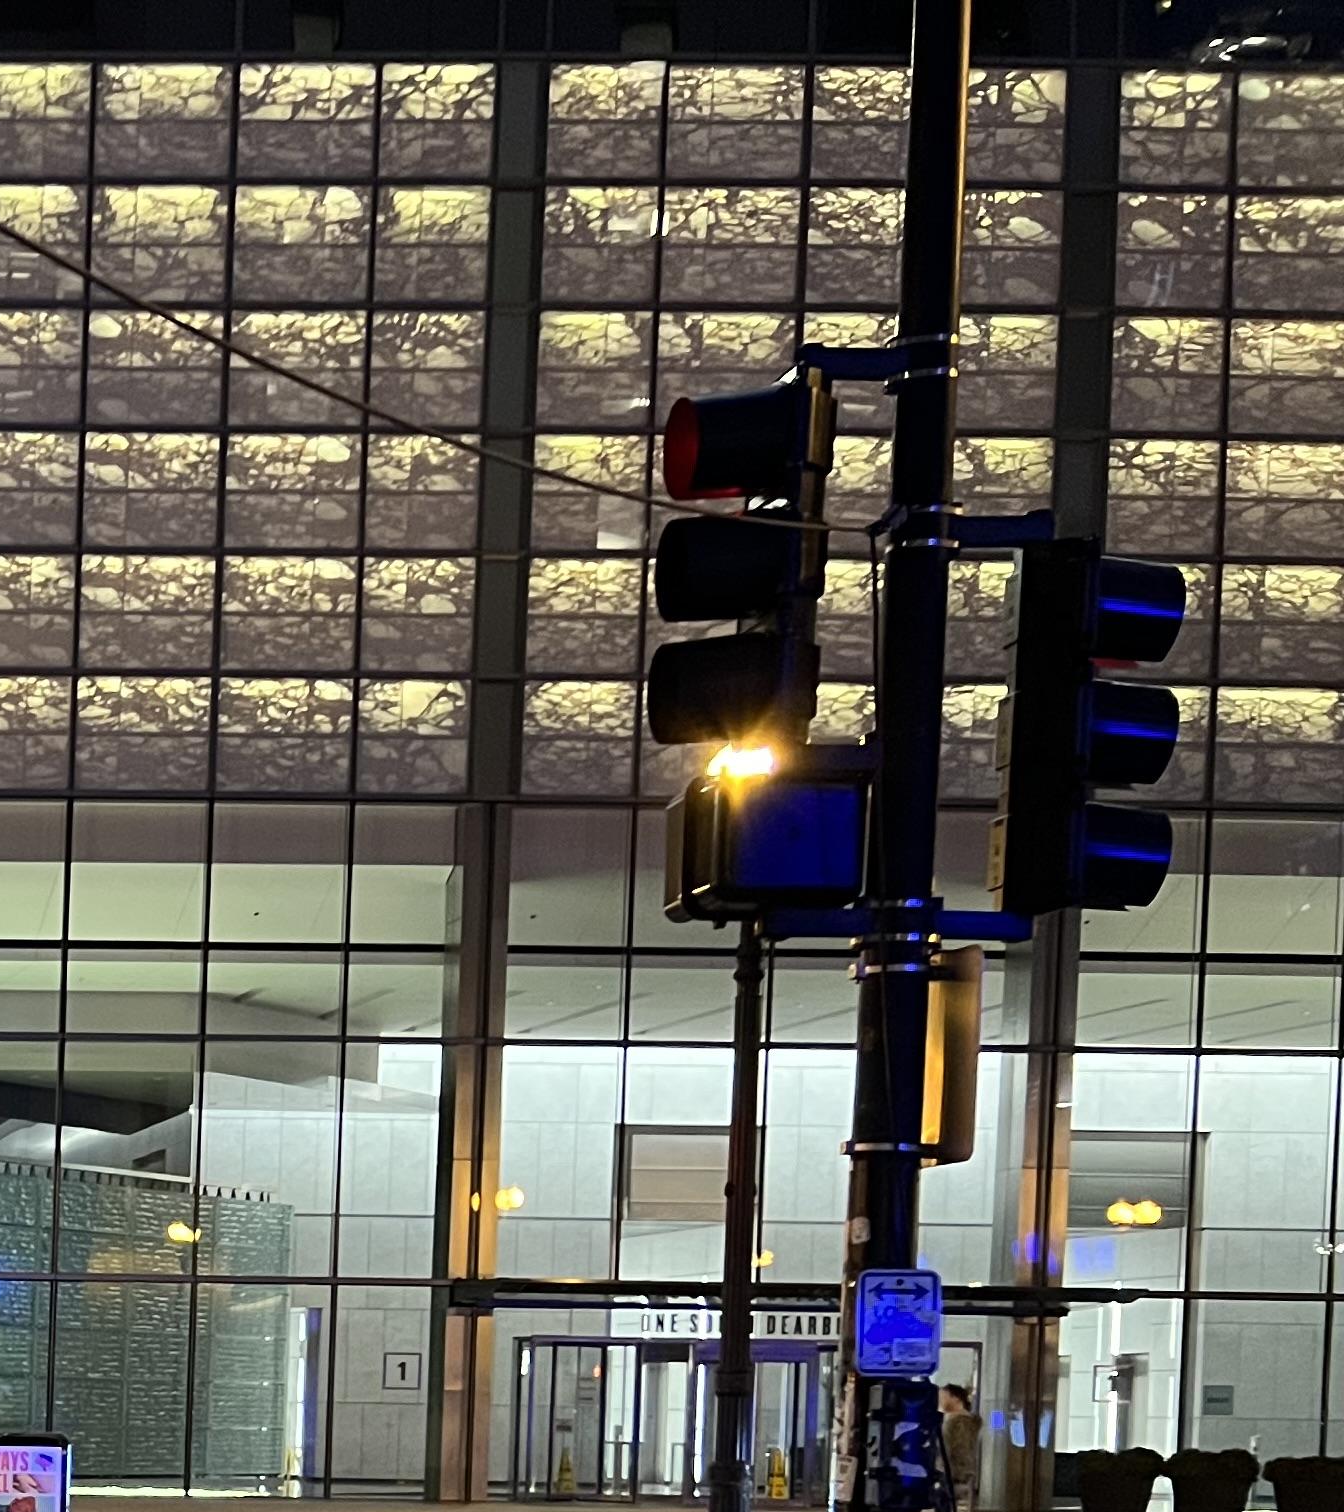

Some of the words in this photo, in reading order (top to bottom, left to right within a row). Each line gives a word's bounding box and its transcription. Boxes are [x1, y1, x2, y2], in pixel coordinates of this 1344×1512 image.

[641, 1314, 679, 1333] ONE
[766, 1315, 841, 1336] DEARB
[397, 1361, 407, 1381] 1
